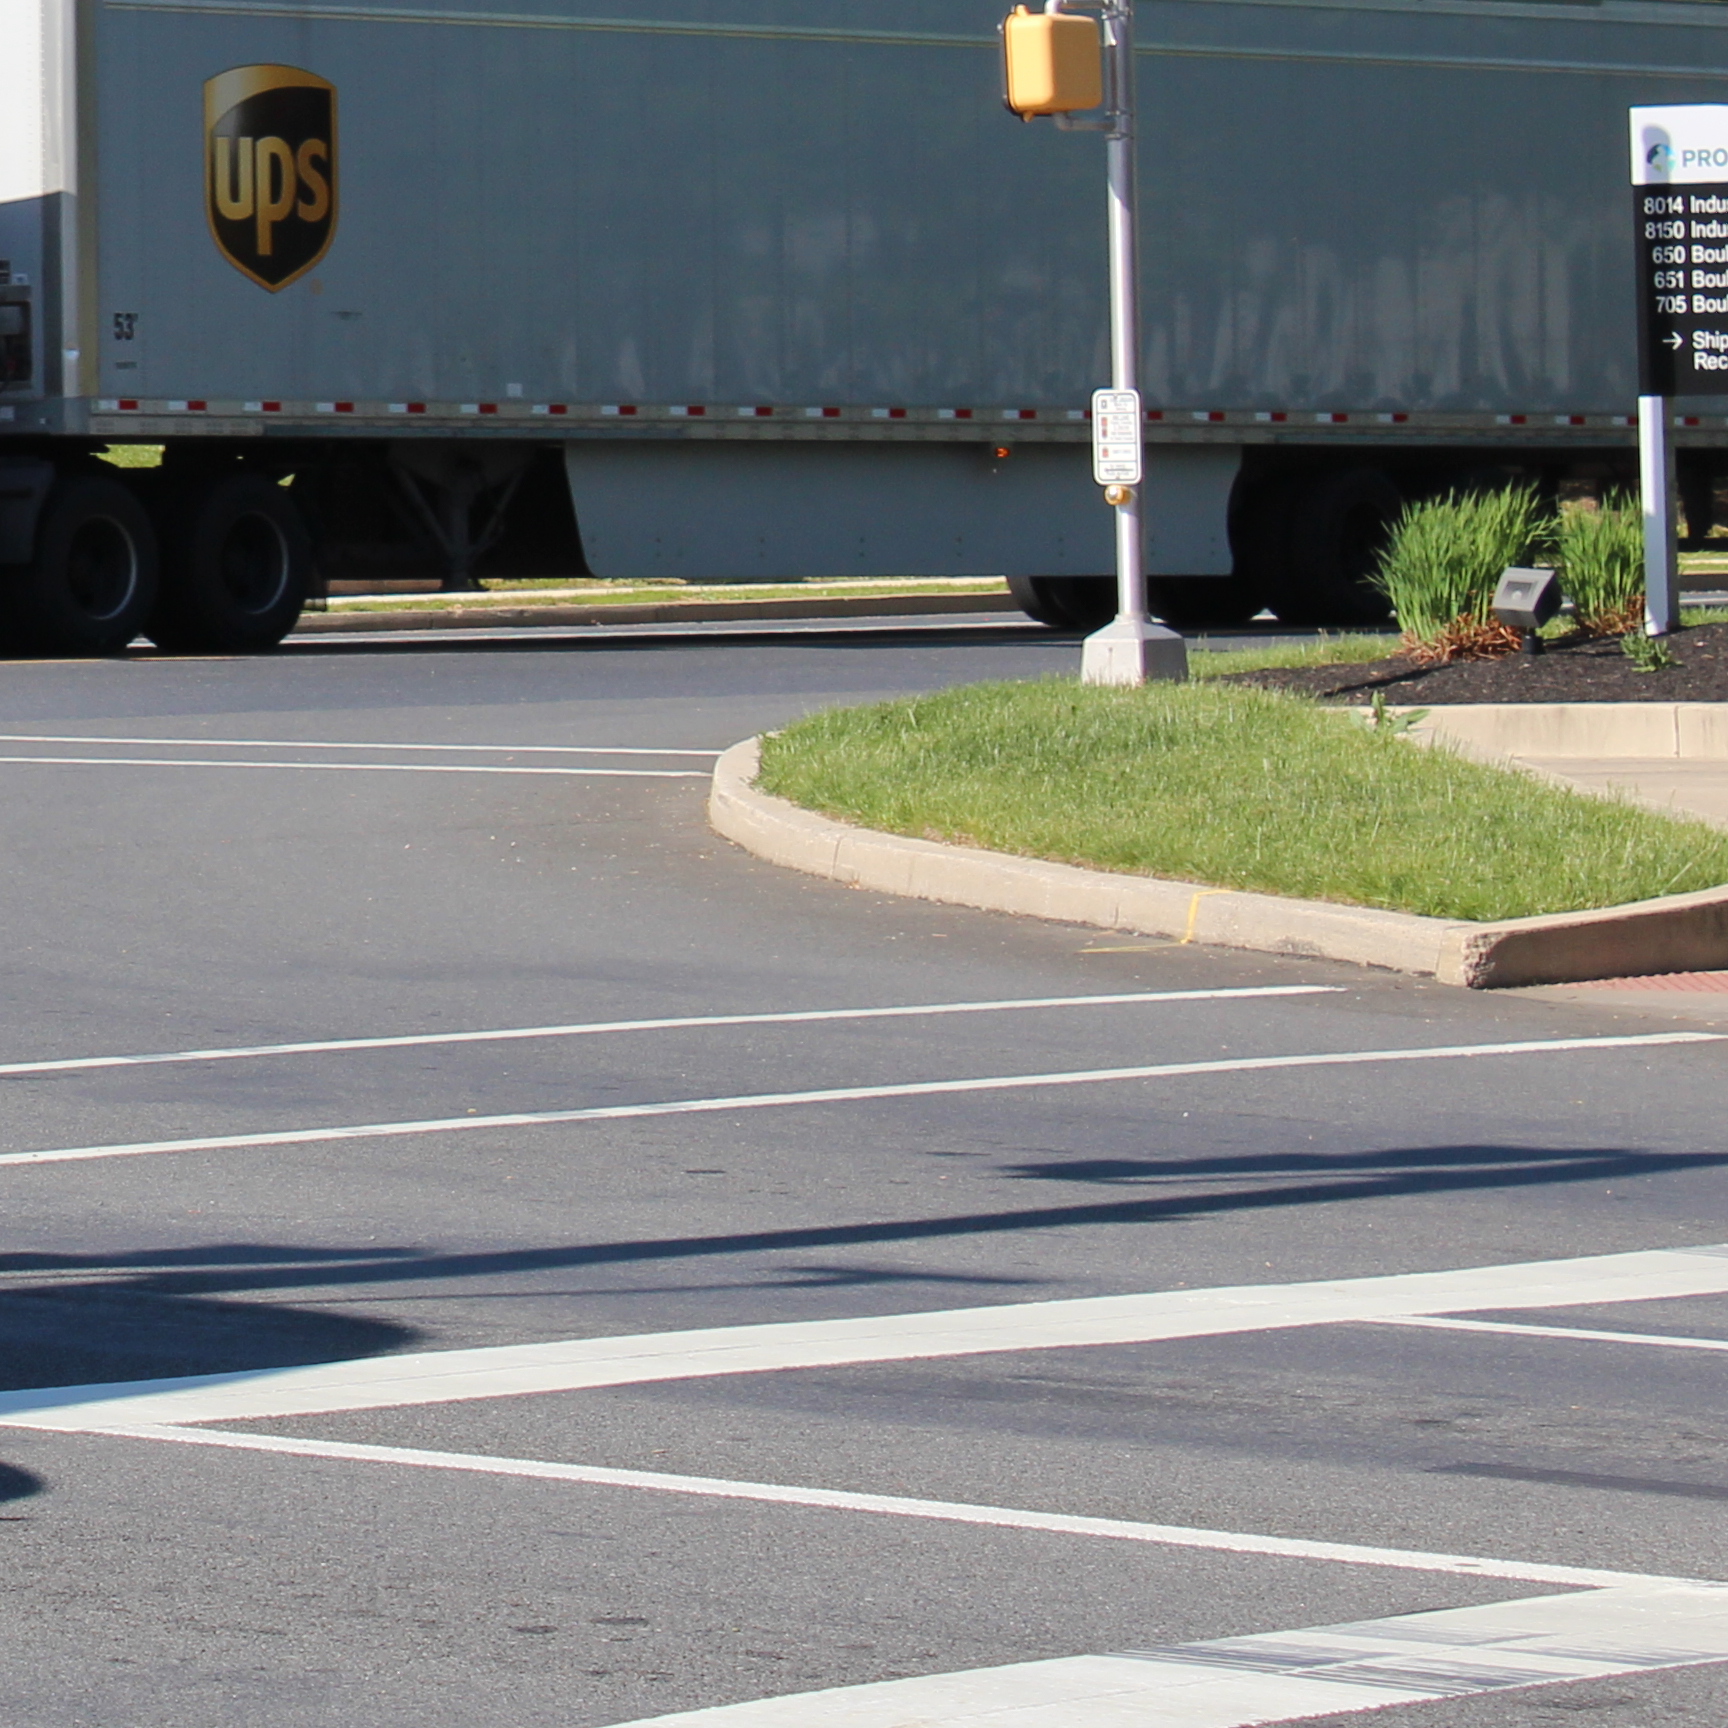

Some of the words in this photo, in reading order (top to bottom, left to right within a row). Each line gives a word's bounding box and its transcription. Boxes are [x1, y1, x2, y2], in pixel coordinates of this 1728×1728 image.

[215, 136, 330, 256] ups
[1644, 196, 1684, 215] 8014
[1690, 194, 1728, 214] Indu
[1645, 220, 1685, 240] 8150
[1691, 219, 1728, 239] Indu
[1652, 245, 1686, 264] 650
[1654, 270, 1684, 288] 651
[1655, 294, 1688, 314] 705
